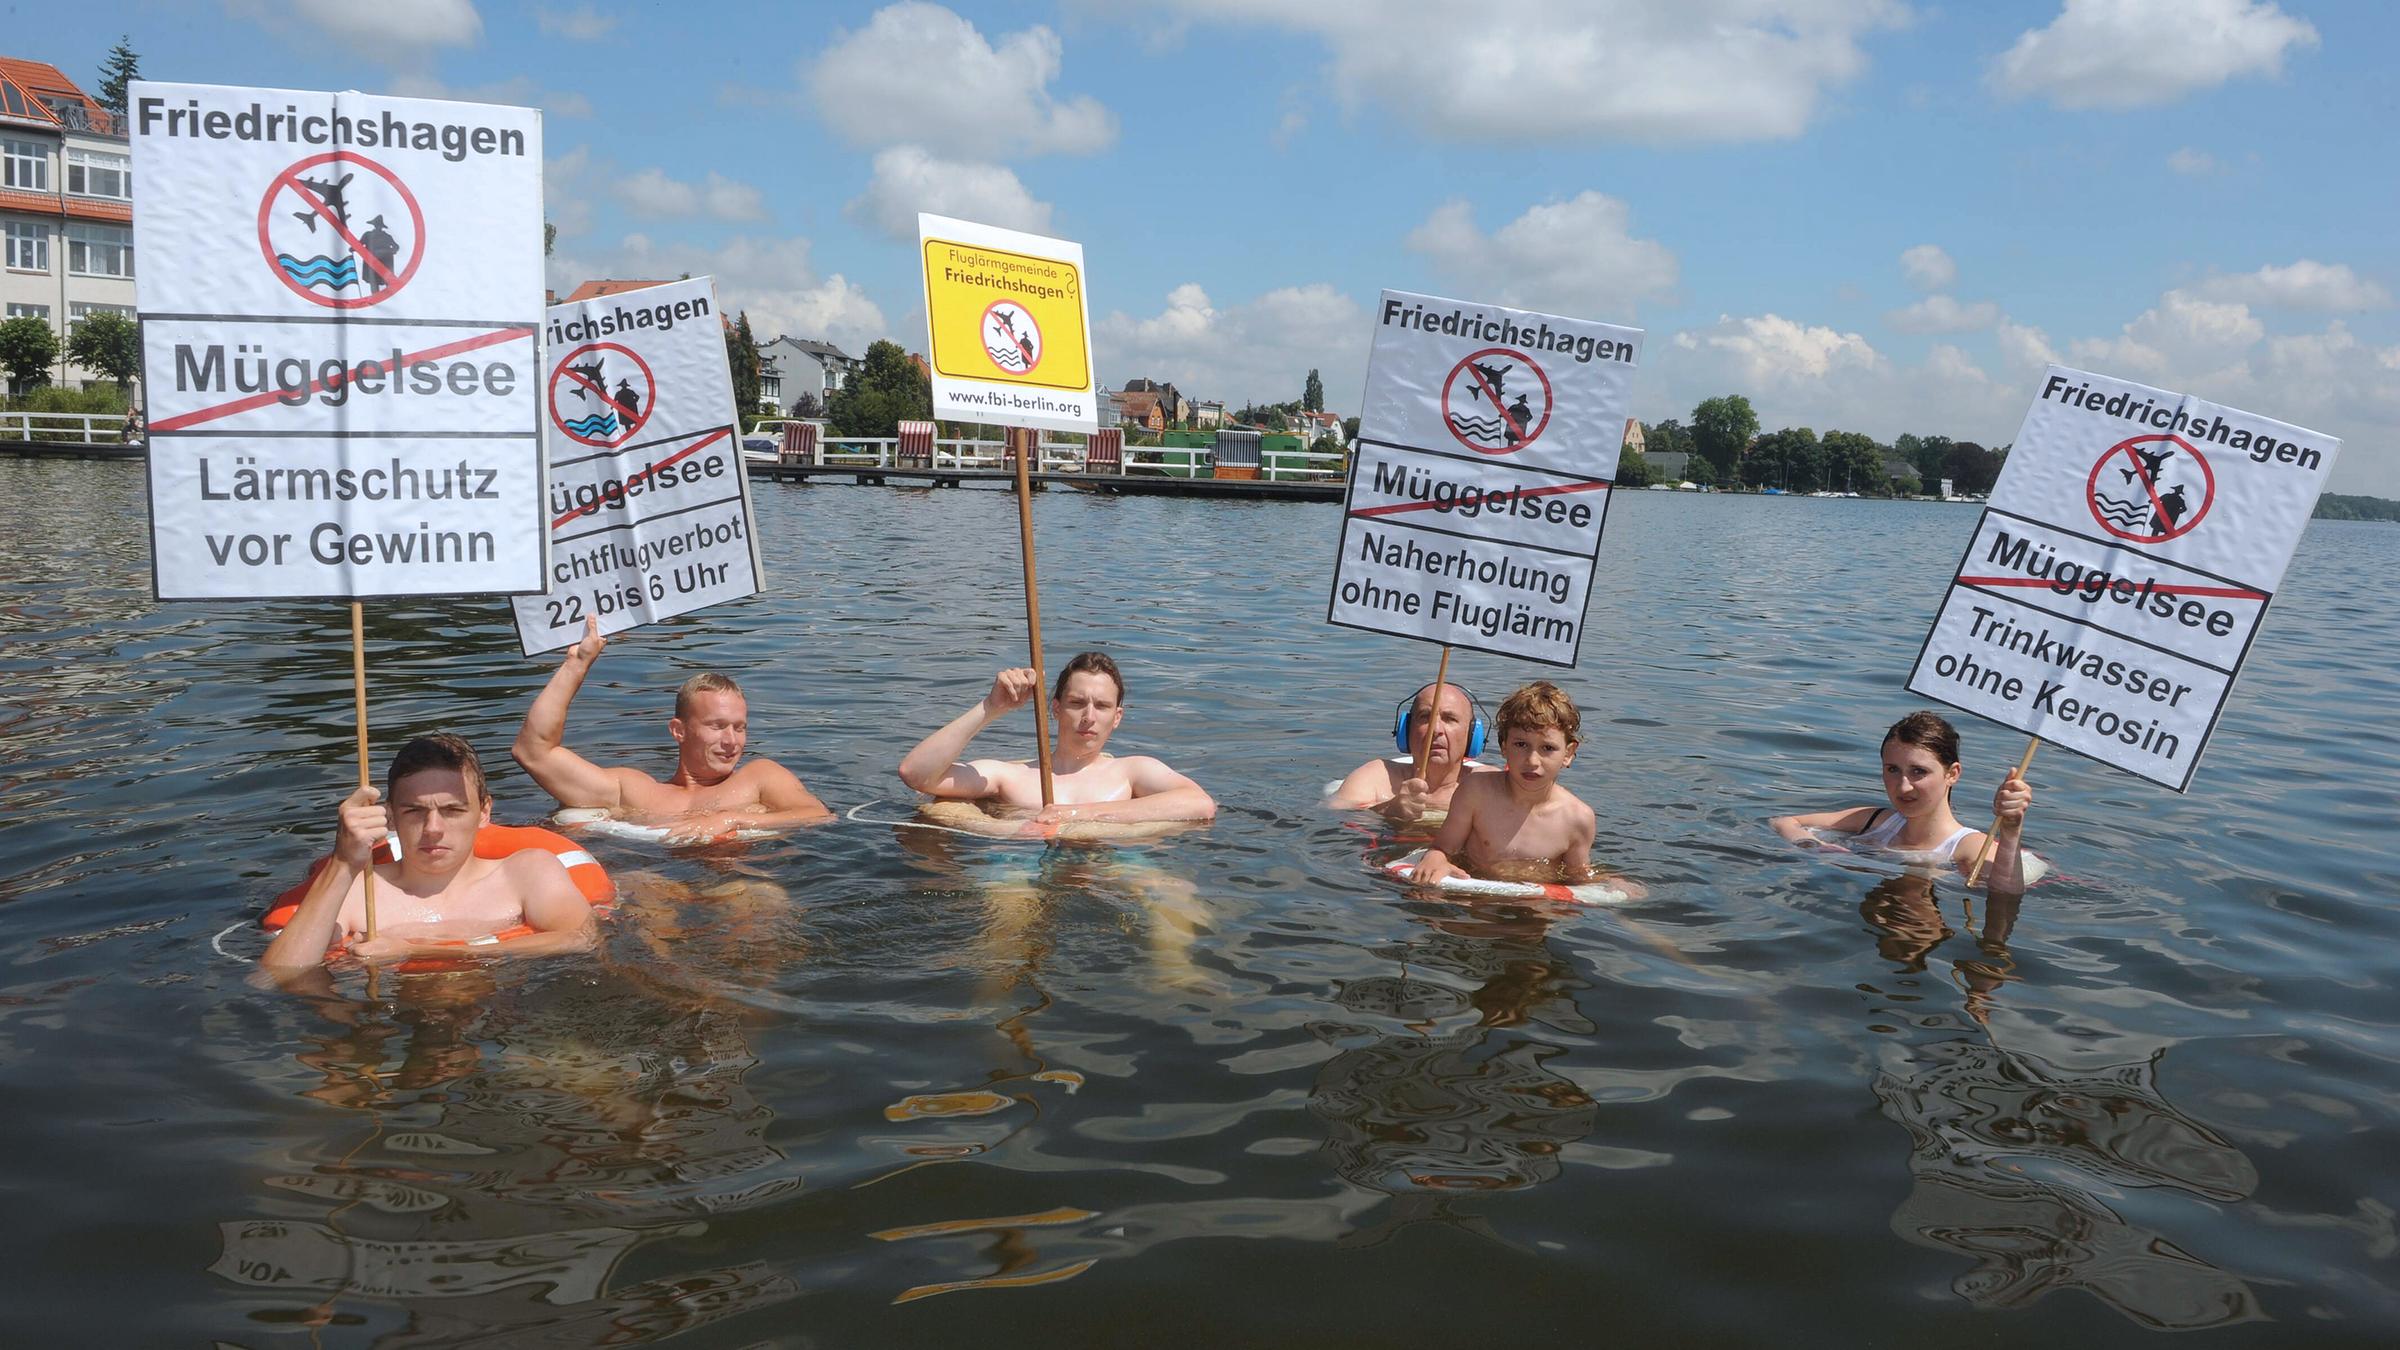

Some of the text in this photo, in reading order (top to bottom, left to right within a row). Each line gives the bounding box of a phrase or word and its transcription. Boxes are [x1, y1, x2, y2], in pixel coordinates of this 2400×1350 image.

[138, 97, 525, 162] Friedrichshagen
[945, 268, 1064, 299] Friedrichshagen
[949, 249, 1057, 279] Fluglärmgemeinde
[547, 297, 710, 347] richshagen
[1383, 300, 1633, 363] Friedrichshagen
[174, 343, 516, 407] Müggelsee
[948, 391, 1081, 416] www.fbi-berlin.org
[2042, 375, 2321, 471] Friedrichshagen
[199, 456, 500, 501] Lärmschutz
[550, 454, 724, 516] üggelsee
[1373, 461, 1591, 528] Müggelsee
[205, 521, 496, 567] vor Gewinn
[554, 515, 742, 584] chtflugverbot
[1361, 532, 1571, 604] Naherholung
[546, 561, 729, 629] 22 bis 6 Uhr
[1341, 578, 1574, 643] ohne Fluglärm
[1986, 532, 2235, 637] Müggelsee
[1968, 606, 2191, 708] Trinkwasser
[1935, 653, 2180, 760] ohne Kerosin
